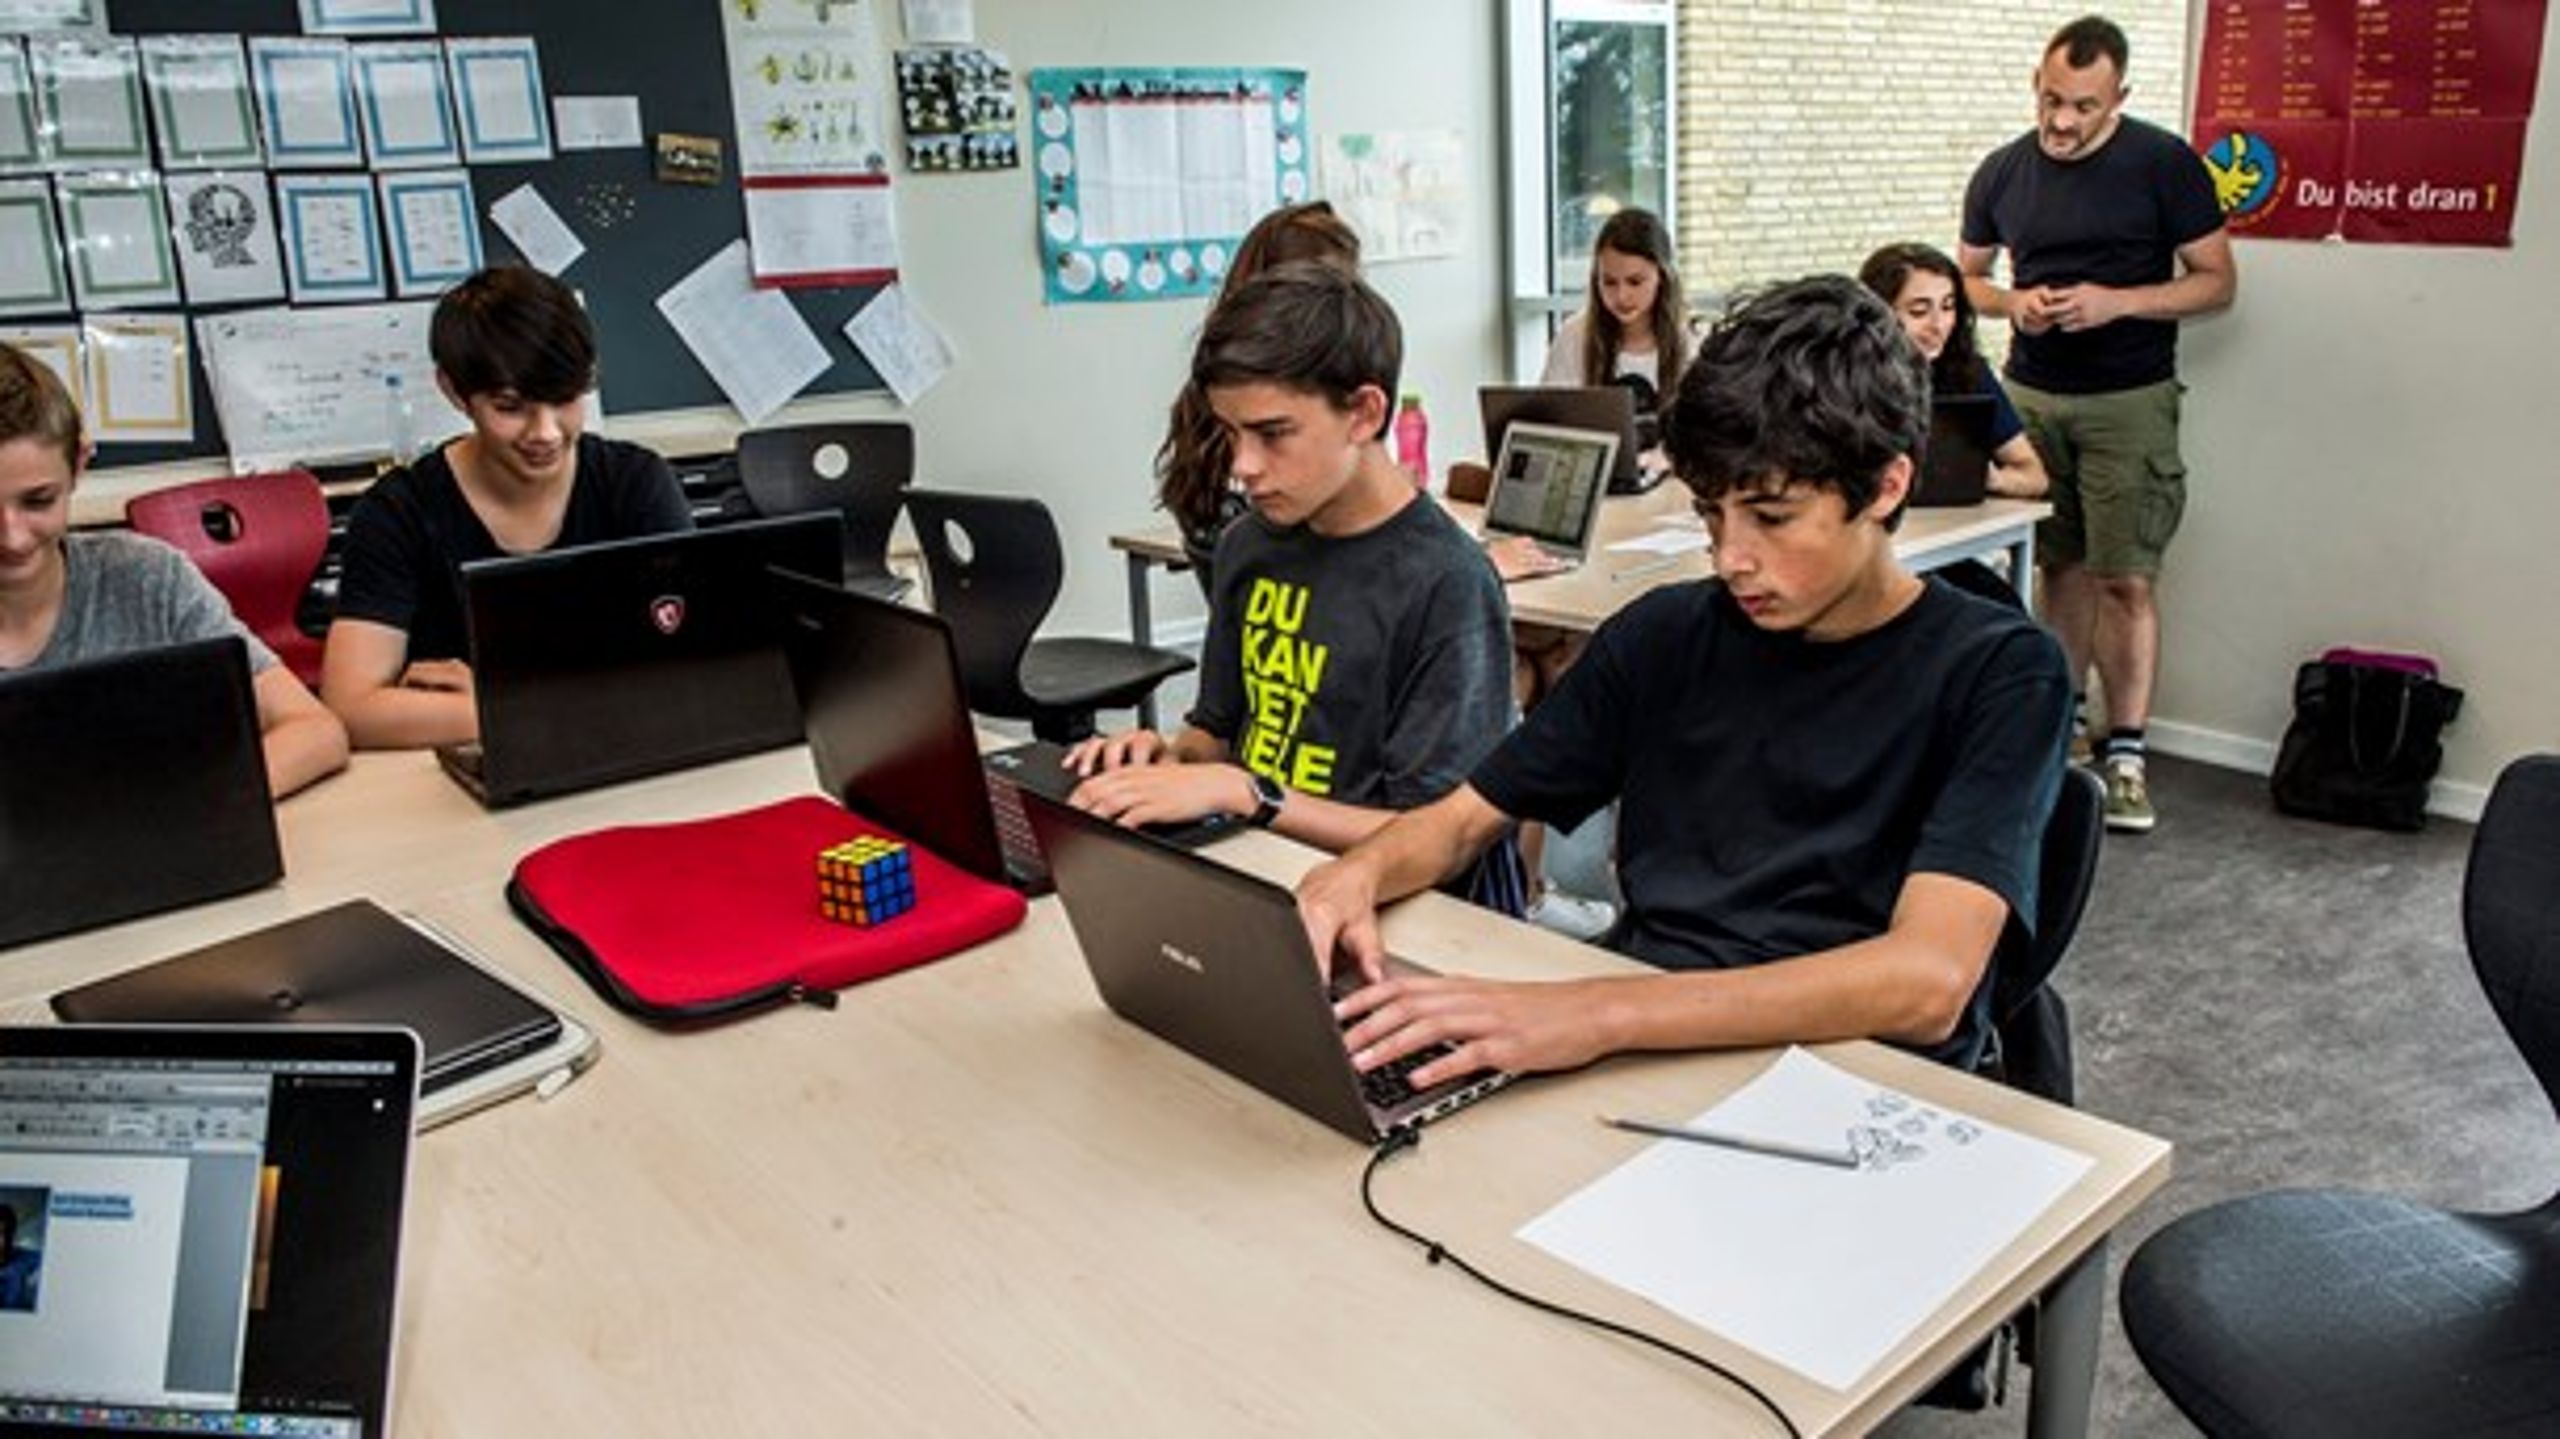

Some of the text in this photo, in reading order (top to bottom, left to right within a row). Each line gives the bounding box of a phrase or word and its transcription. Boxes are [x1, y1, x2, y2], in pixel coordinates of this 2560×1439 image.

[2297, 178, 2335, 208] Du
[2344, 179, 2398, 210] bist
[2407, 180, 2478, 211] dran
[2485, 182, 2498, 211] 1
[1246, 578, 1309, 633] DU
[1241, 624, 1327, 693] KAN
[1241, 724, 1336, 795] ELE
